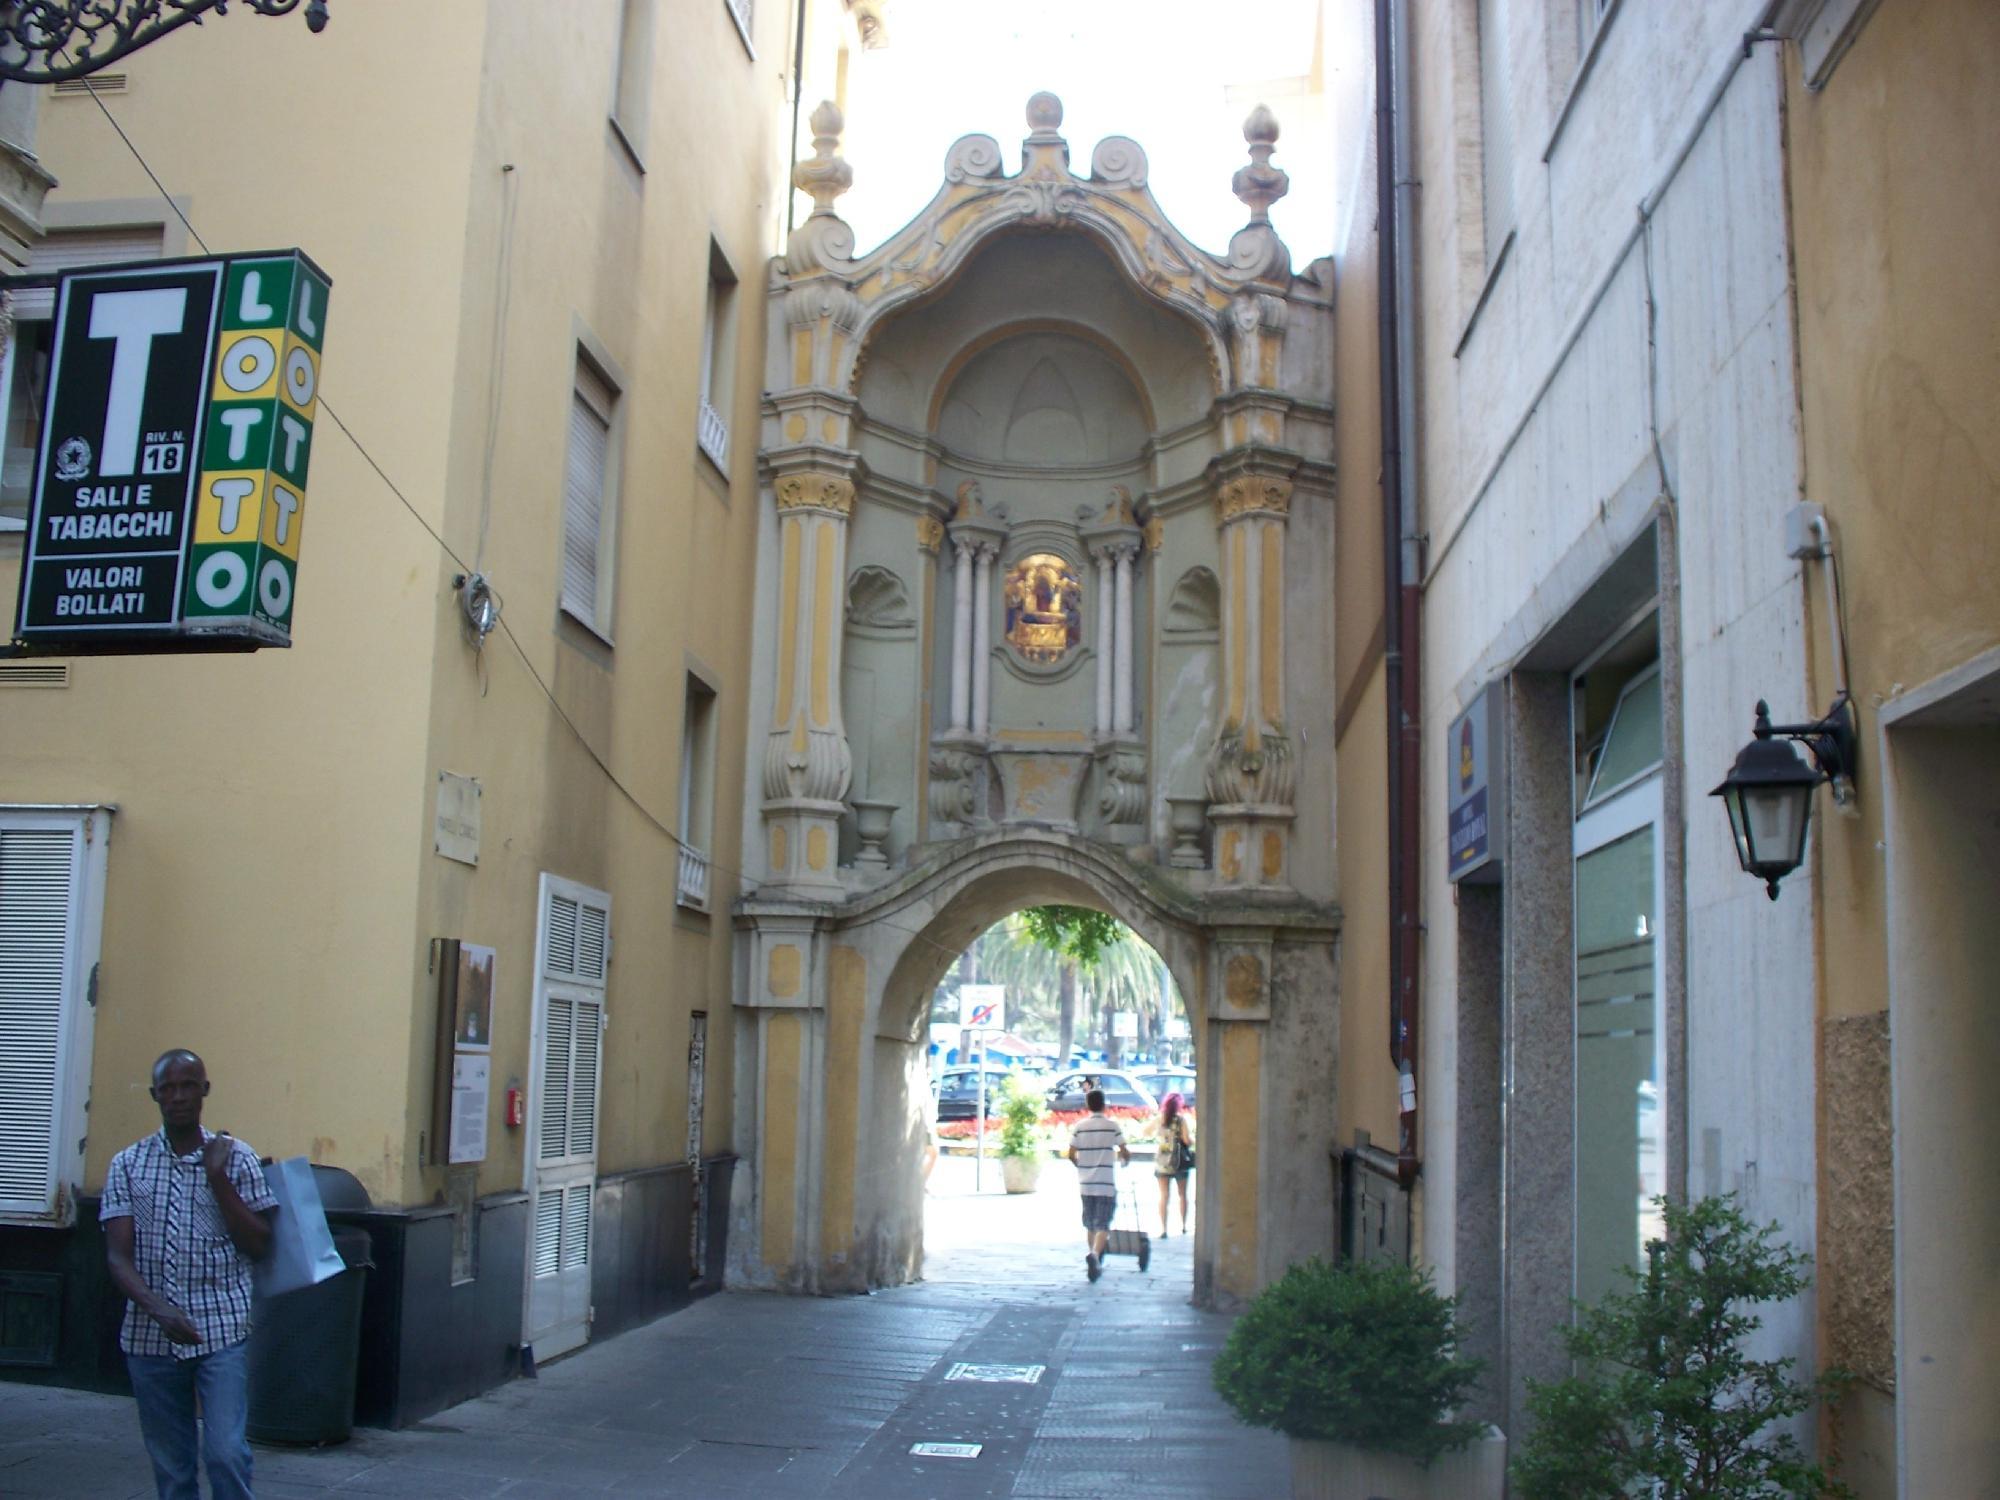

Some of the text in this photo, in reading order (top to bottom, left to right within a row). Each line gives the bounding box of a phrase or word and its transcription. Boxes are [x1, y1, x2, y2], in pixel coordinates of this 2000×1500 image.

[88, 287, 188, 477] T
[145, 431, 170, 443] RIV.
[196, 270, 276, 608] LOTTO
[258, 279, 316, 618] LOTTO
[147, 447, 178, 470] 18
[75, 484, 152, 508] SALI E
[49, 511, 172, 540] TABACCHI
[65, 566, 143, 588] VALORI
[56, 593, 145, 616] BOLLATI
